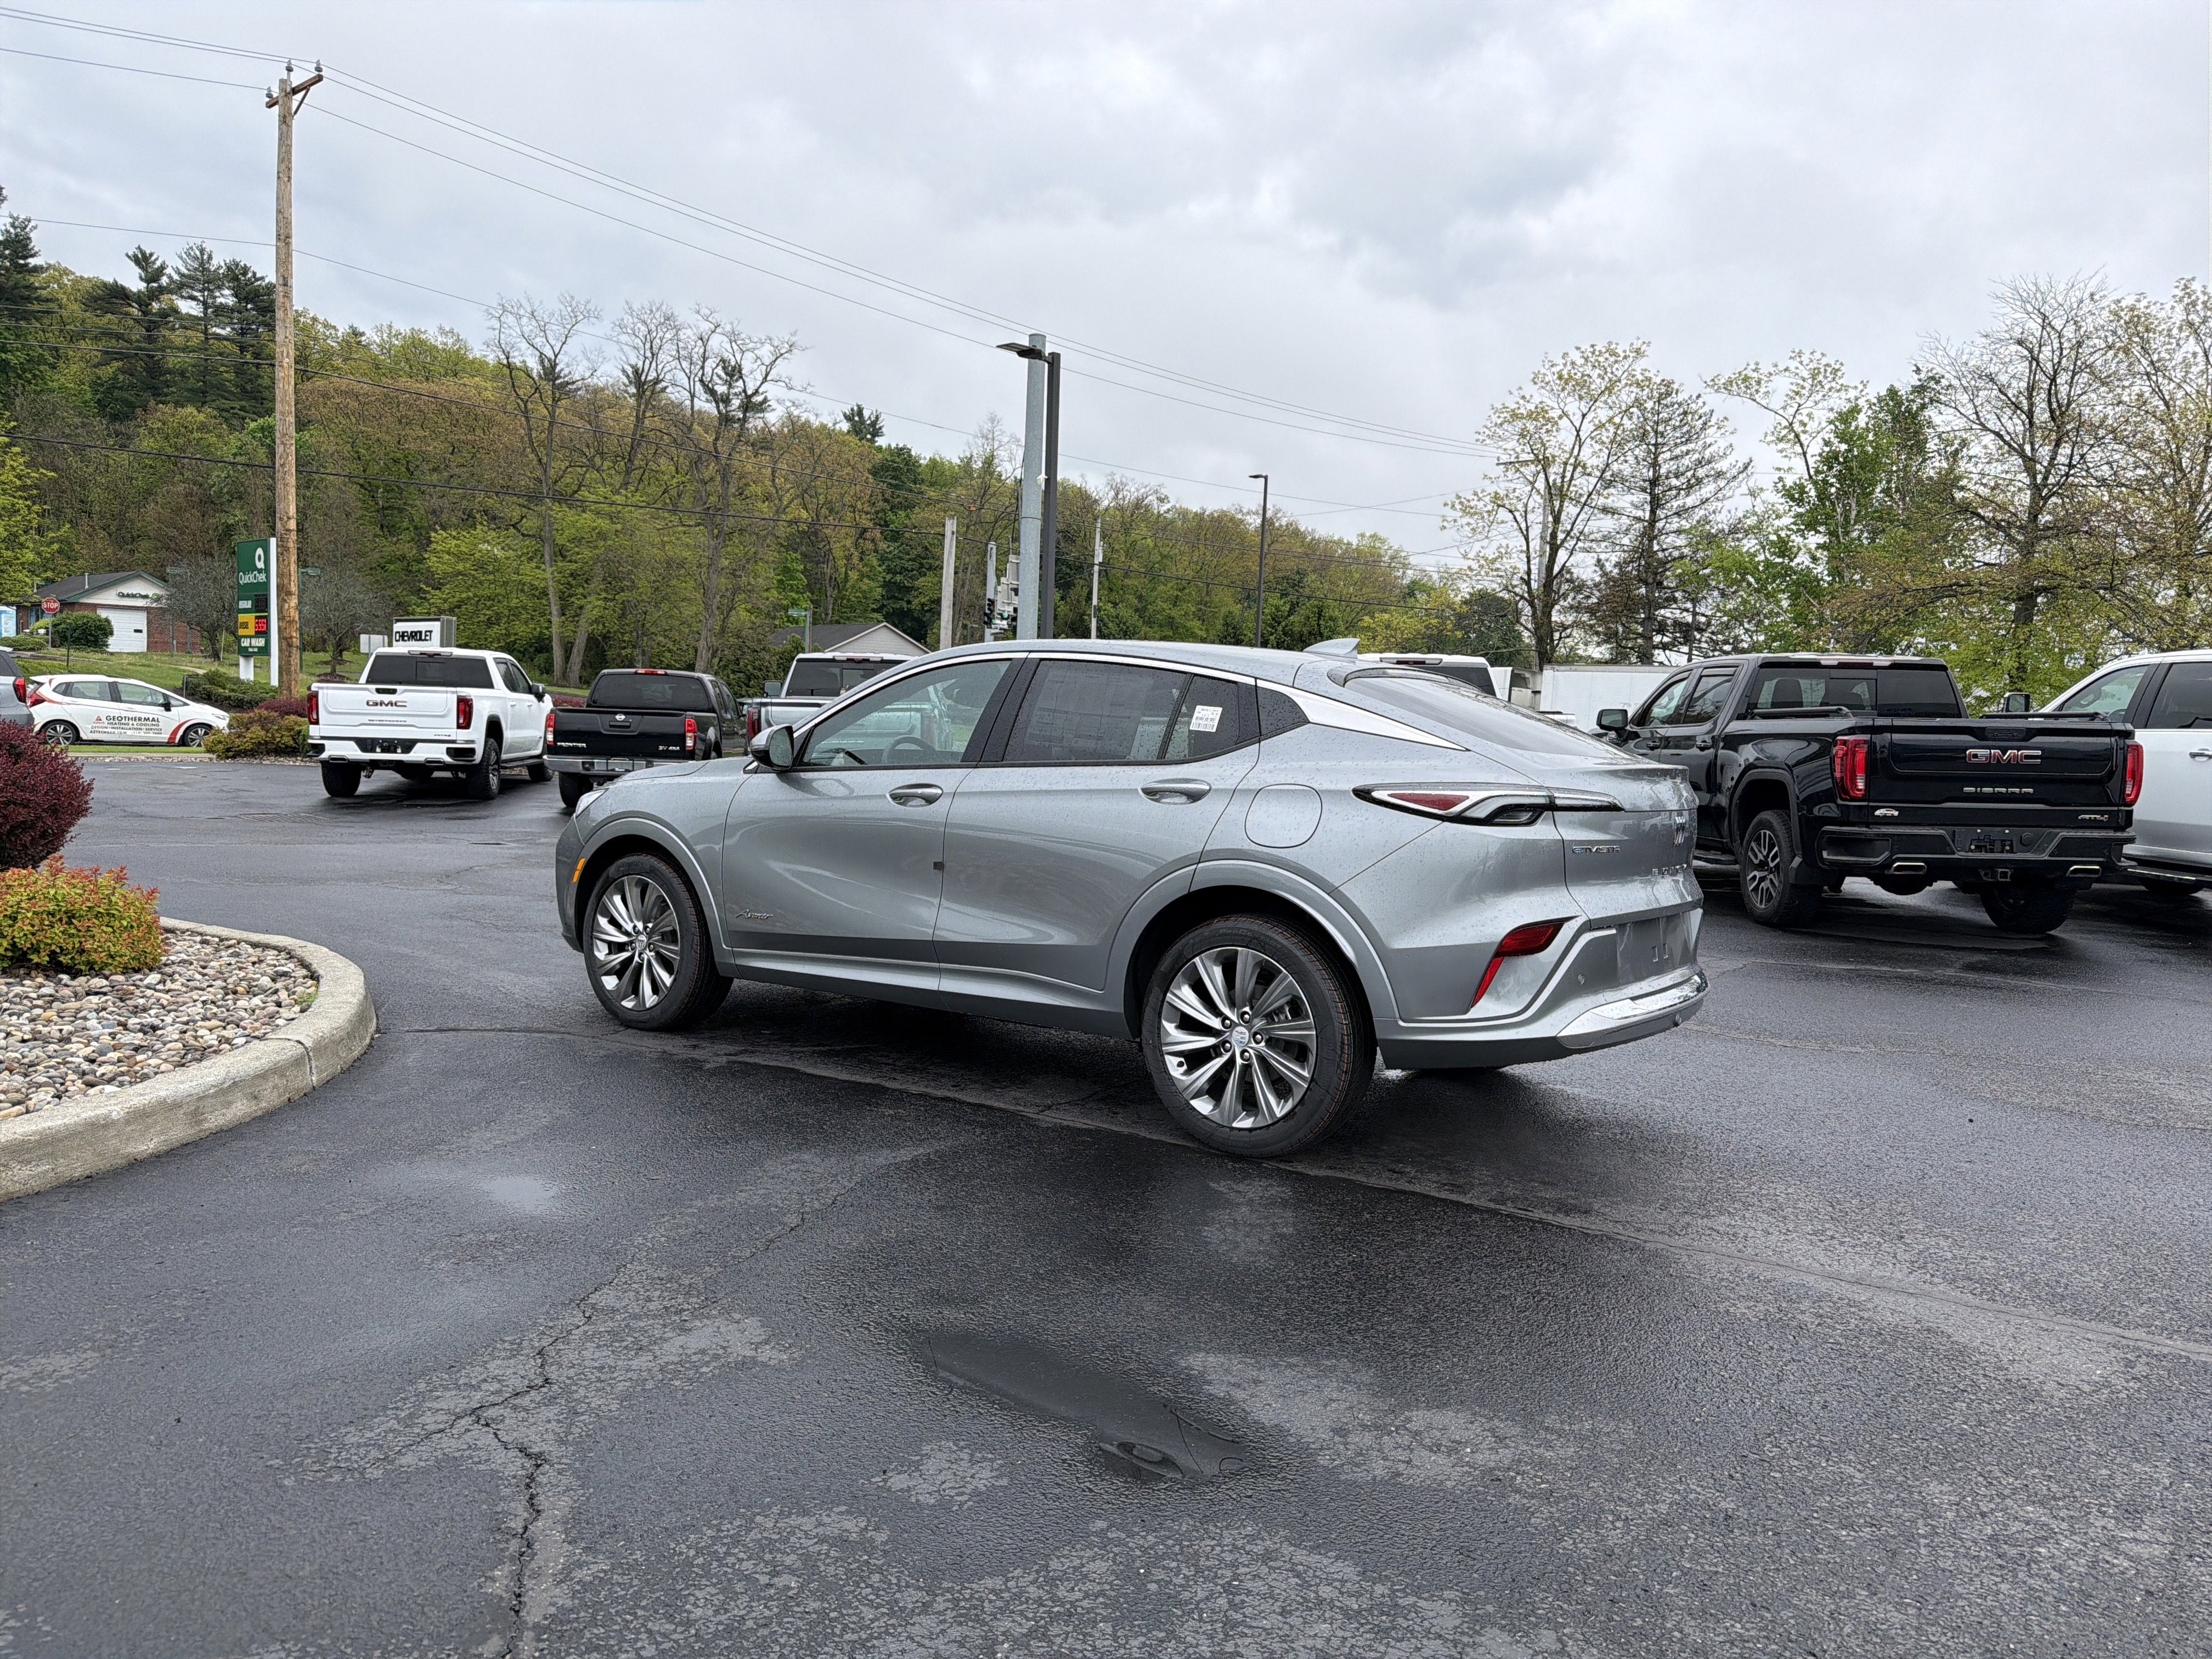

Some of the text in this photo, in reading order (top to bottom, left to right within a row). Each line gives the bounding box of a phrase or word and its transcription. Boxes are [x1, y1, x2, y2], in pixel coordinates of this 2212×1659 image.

[239, 569, 267, 585] QuickChek
[394, 630, 433, 642] CHEVROLET
[241, 638, 265, 647] CAR WASH
[366, 699, 408, 708] GMC
[105, 715, 161, 723] GEOTHERMAL
[1966, 749, 2042, 764] GMC
